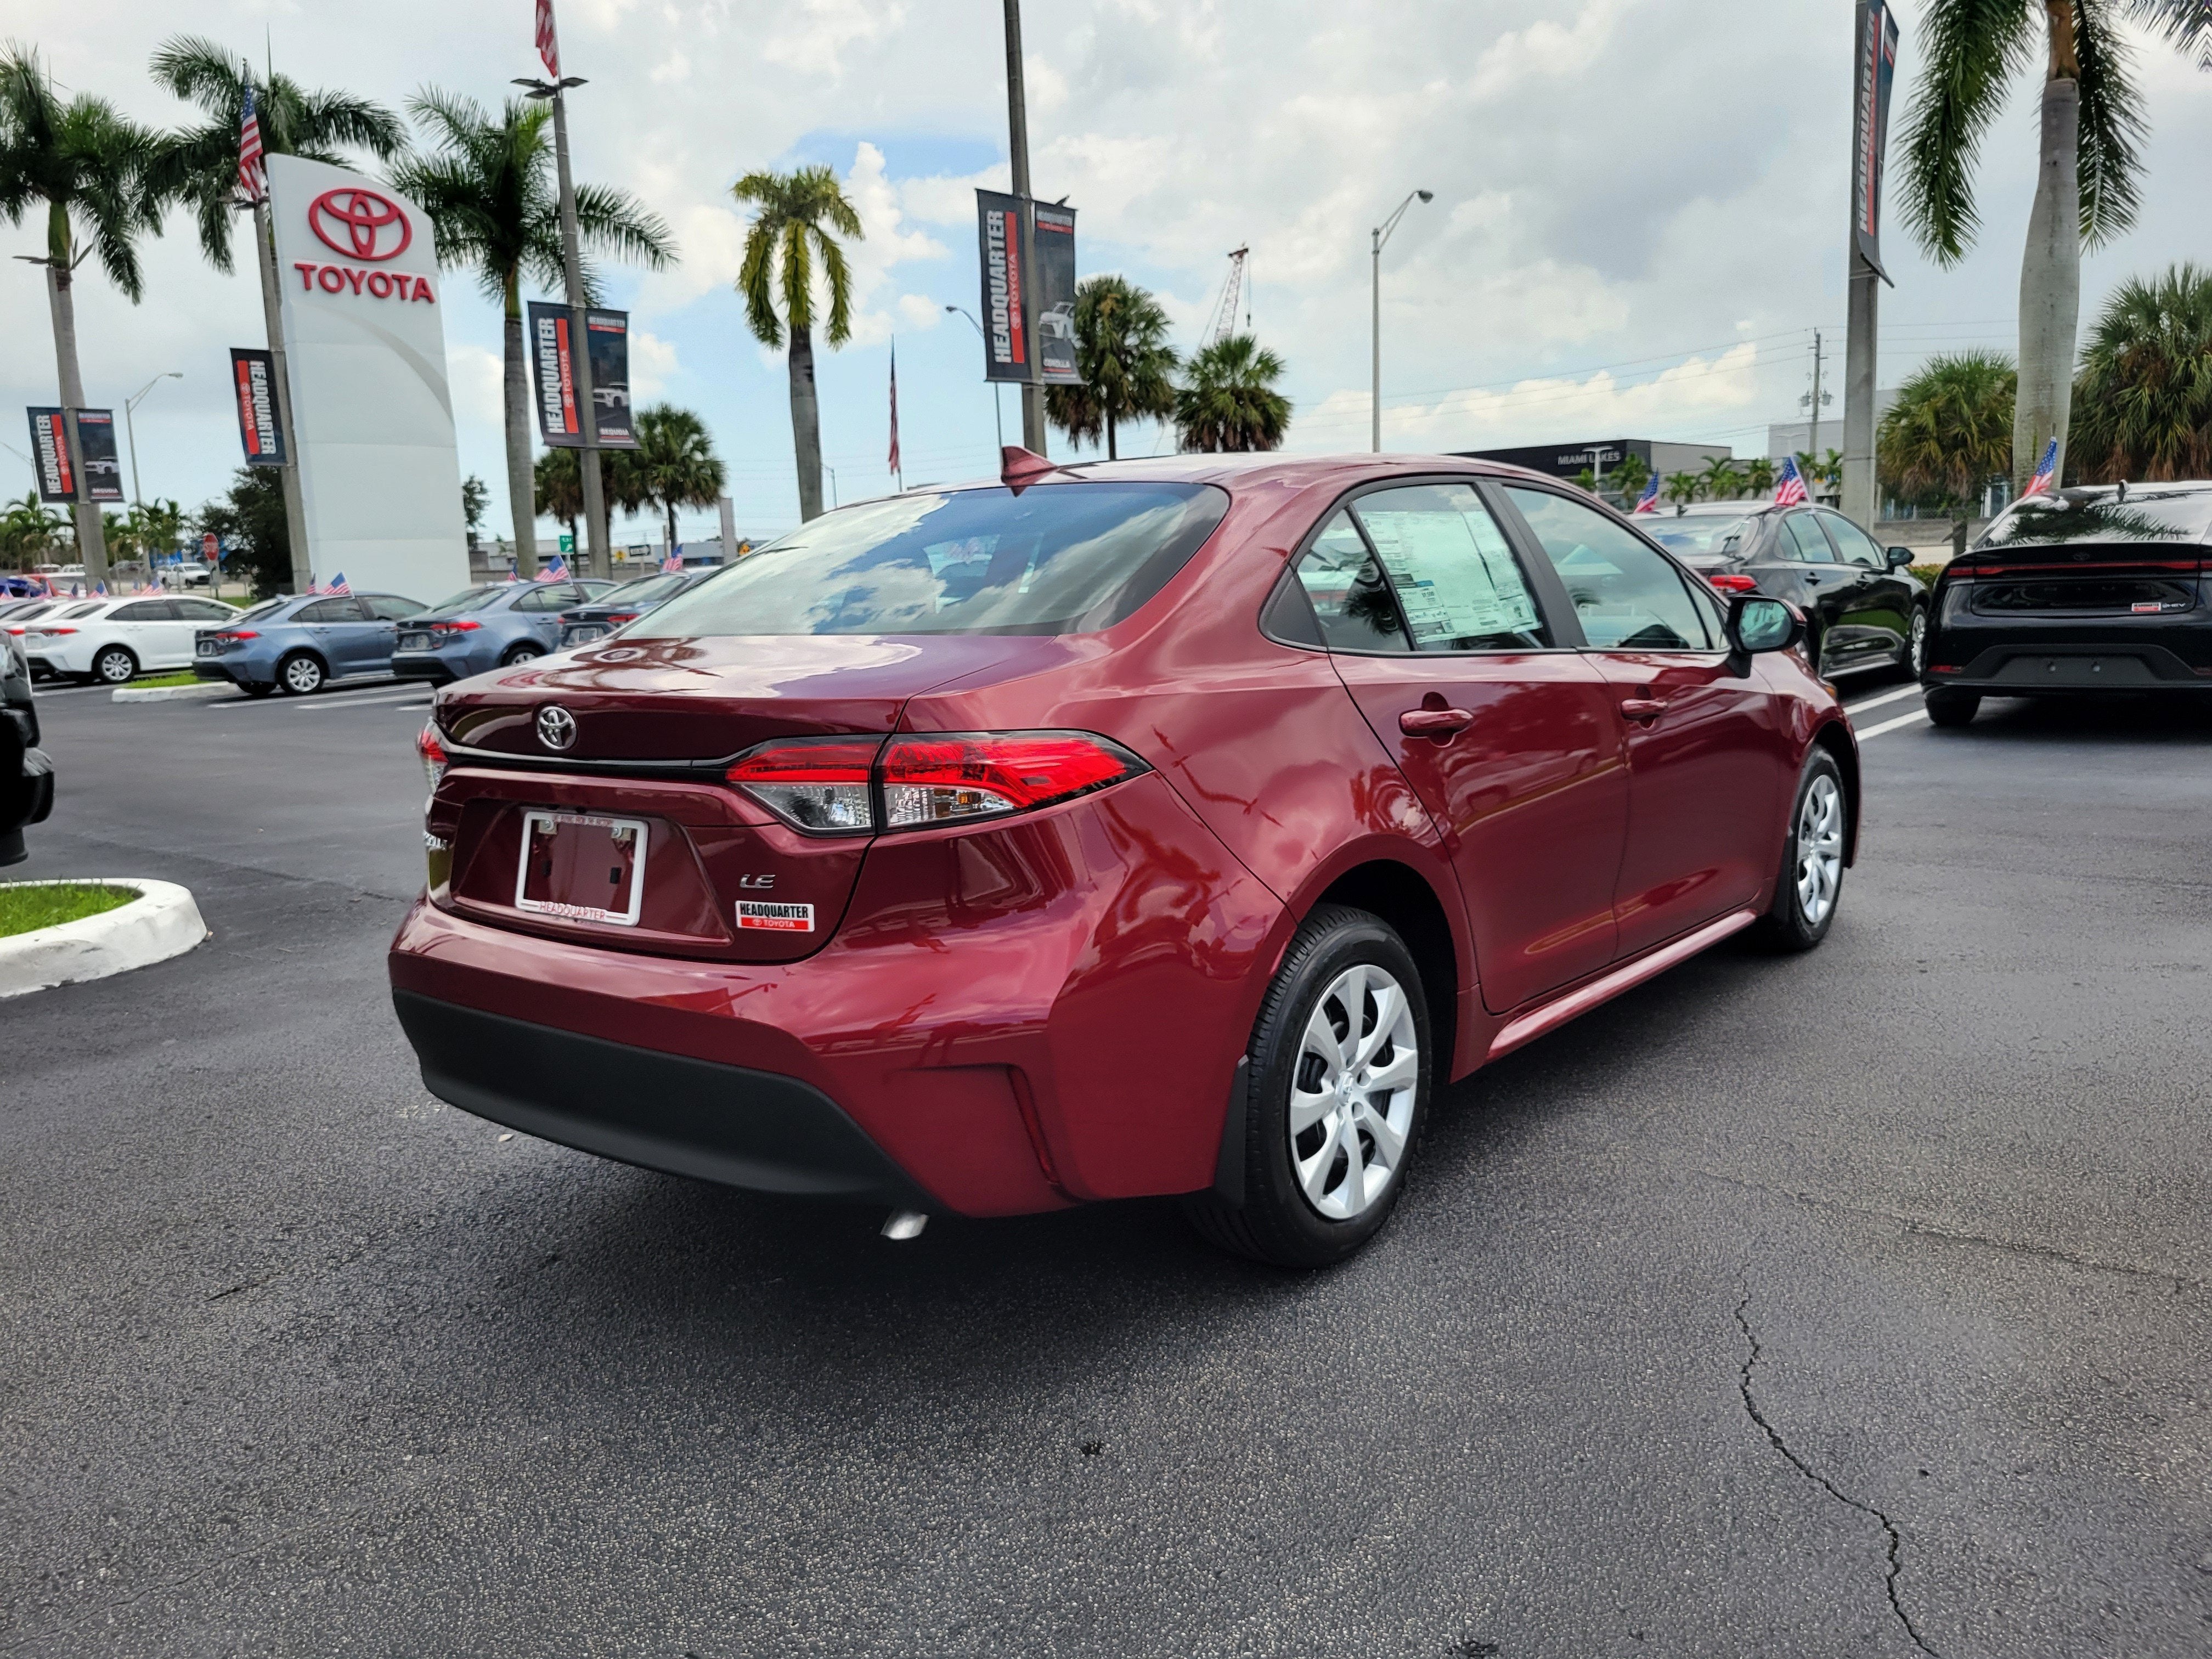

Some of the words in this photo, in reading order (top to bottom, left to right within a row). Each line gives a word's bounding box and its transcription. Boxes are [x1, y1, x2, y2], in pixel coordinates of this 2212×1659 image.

[1859, 9, 1875, 233] HEADQUARTER
[295, 263, 435, 303] TOYOTA
[987, 210, 1012, 363] HEADQUARTER
[1009, 253, 1020, 309] TOYOTA
[537, 318, 566, 433] HEADQUARTER
[560, 350, 572, 392] TOYOTA
[243, 393, 255, 430] TOYOTA
[249, 360, 276, 454] HEADQUARTER
[36, 415, 62, 494] HEADQUARTER
[1558, 454, 1588, 465] MIAMI
[1589, 451, 1621, 463] LKES
[740, 874, 776, 889] LE
[540, 901, 605, 919] HEADQUARTER
[740, 903, 808, 918] HEADQUARTER
[764, 919, 795, 928] TOYOTA
